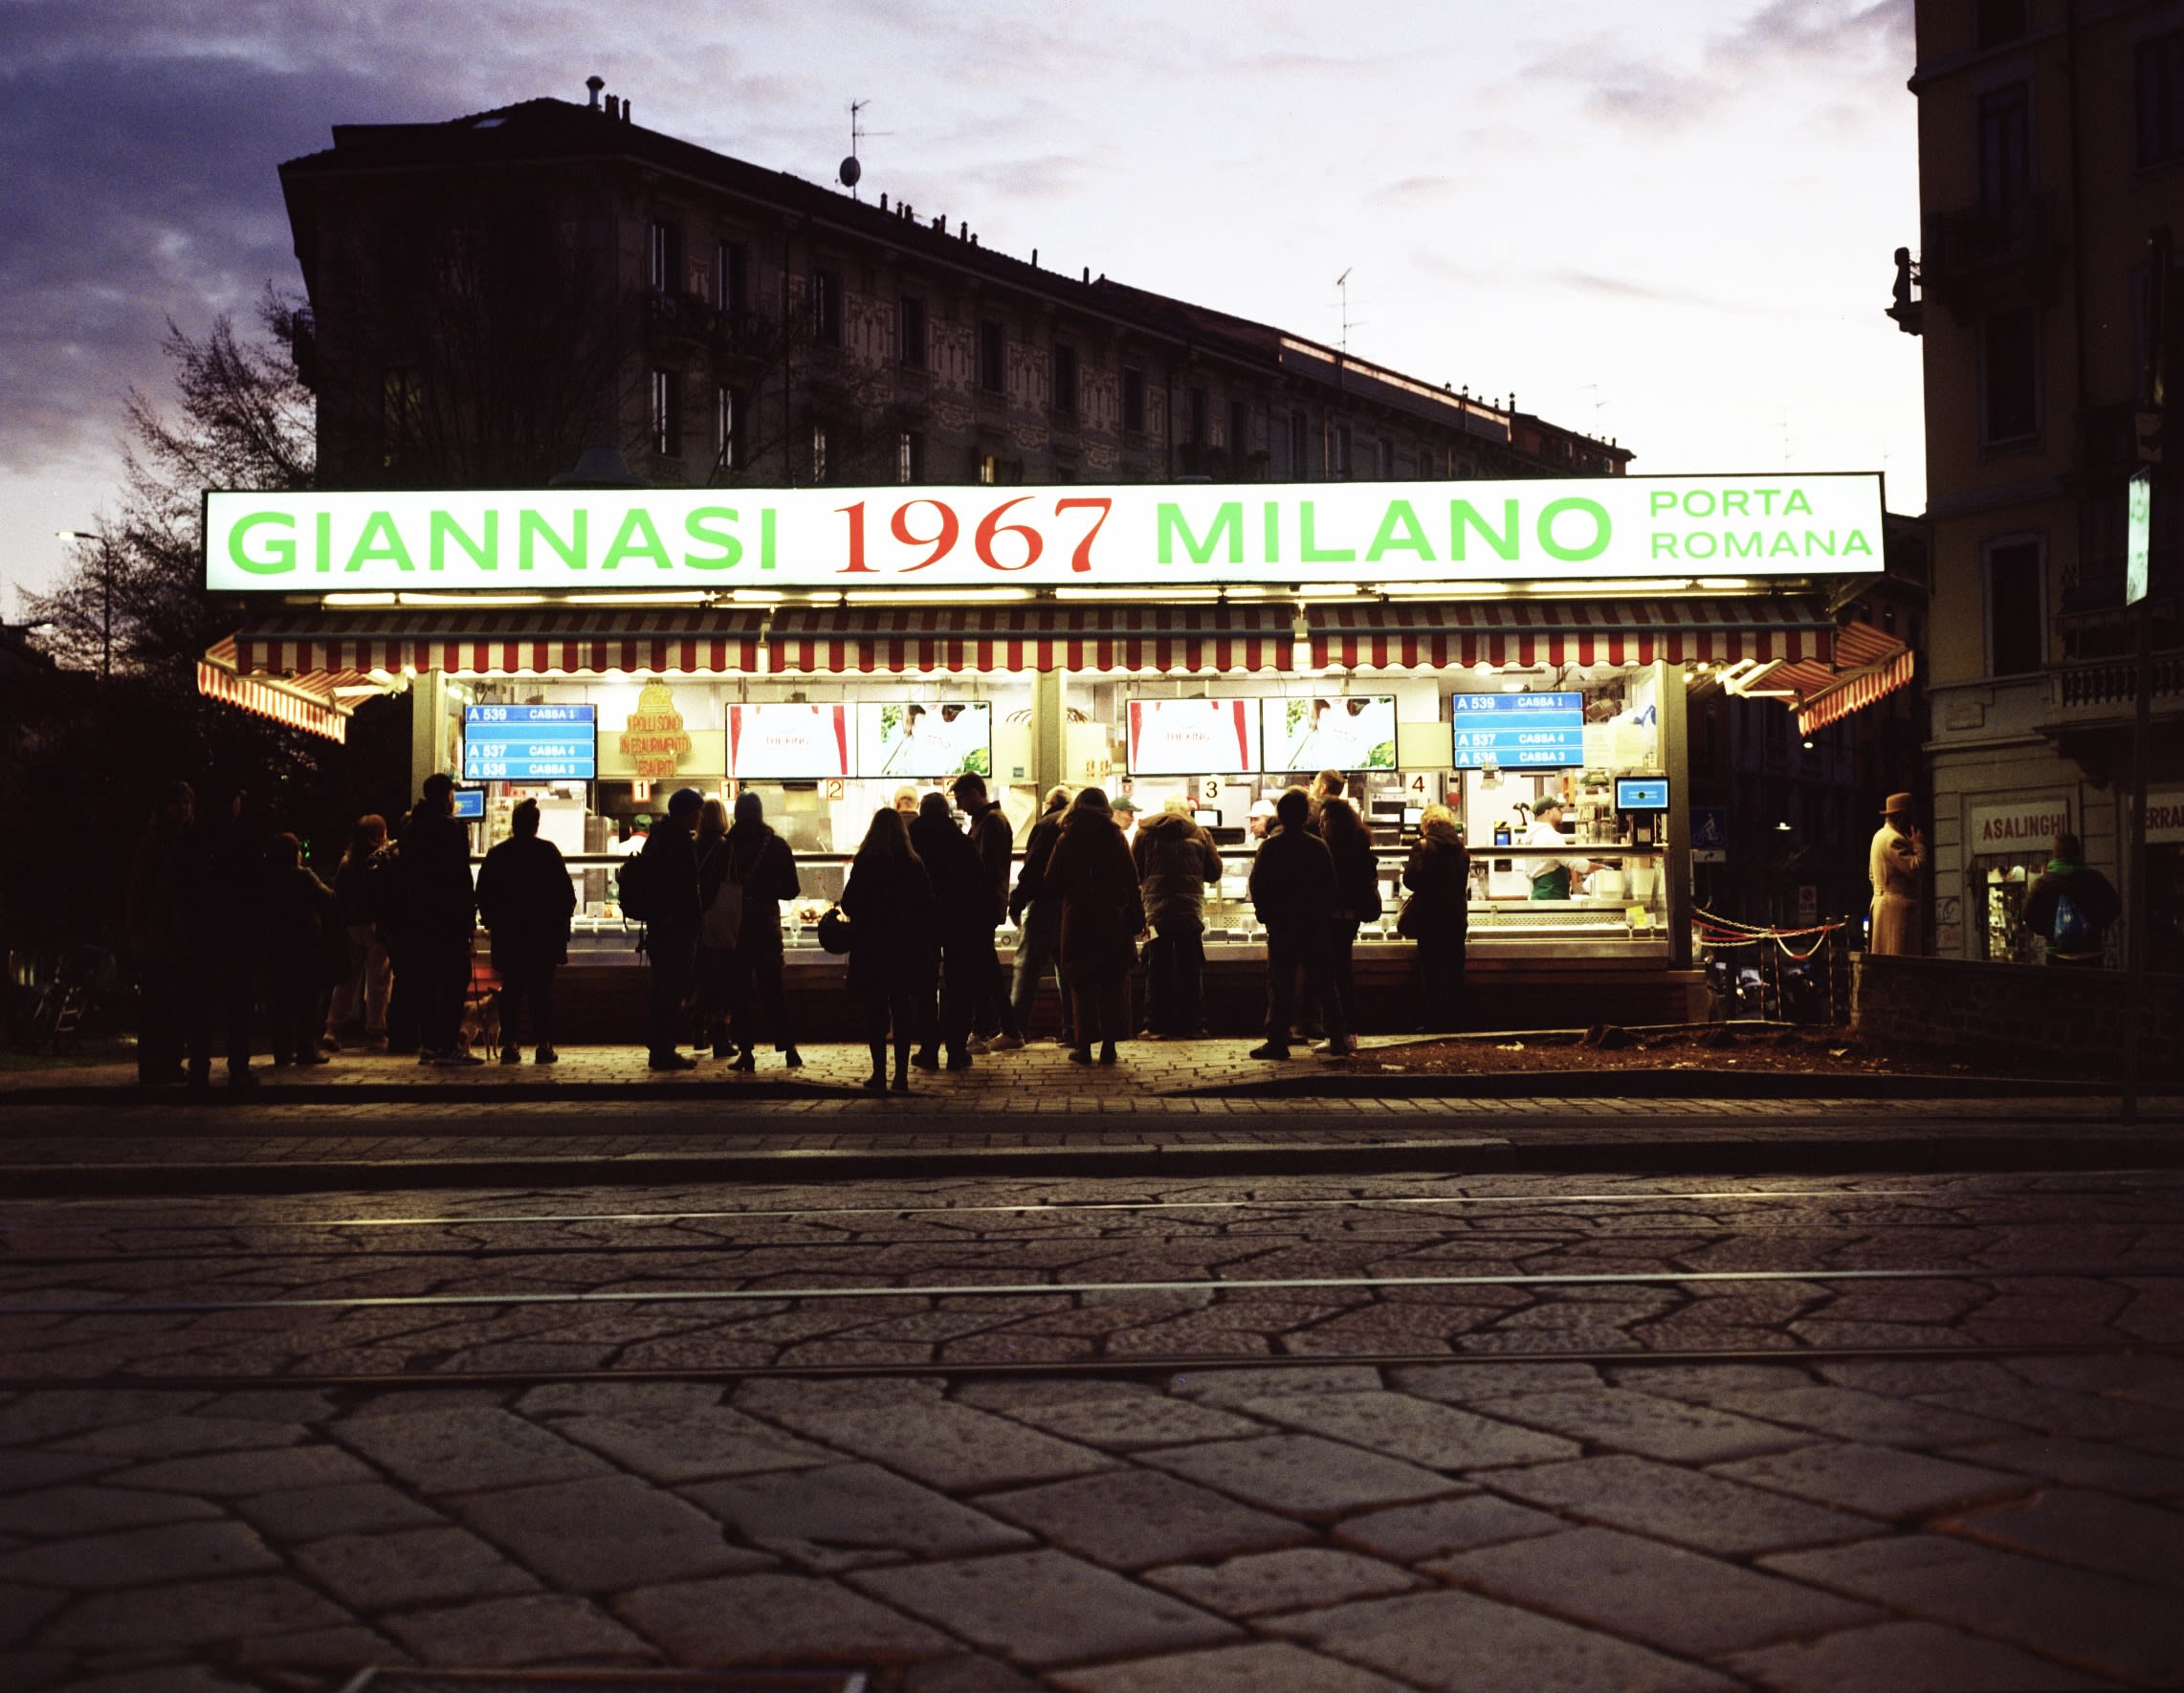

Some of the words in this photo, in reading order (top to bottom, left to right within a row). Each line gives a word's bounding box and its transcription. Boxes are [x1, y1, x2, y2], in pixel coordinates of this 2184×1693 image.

[1649, 489, 1812, 517] PORTA
[228, 506, 777, 575] GIANNASI
[834, 496, 1113, 573] 1967
[1158, 497, 1612, 564] MILANO
[1650, 530, 1873, 559] ROMANA
[1457, 697, 1467, 710] A
[1471, 696, 1495, 710] 539
[1517, 696, 1555, 708] CASSA
[1557, 696, 1563, 707] 1
[469, 708, 479, 720] A
[483, 708, 507, 720] 539
[529, 709, 566, 720] CASSA
[1458, 734, 1468, 746] A
[1472, 734, 1496, 746] 537
[1518, 734, 1555, 744] CASSA
[1557, 734, 1564, 743] 4
[469, 744, 479, 758] A
[483, 744, 507, 758] 537
[529, 745, 566, 757] CASSA
[568, 745, 575, 757] 4
[1459, 753, 1469, 764] A
[1519, 752, 1556, 762] CASSA
[1558, 752, 1565, 761] 3
[469, 763, 479, 776] A
[529, 763, 566, 775] CASSA
[829, 781, 841, 799] 2
[1205, 781, 1218, 798] 3
[1411, 775, 1425, 793] 4
[2129, 805, 2184, 830] ERRA
[1983, 813, 2066, 841] ASALINGHI
